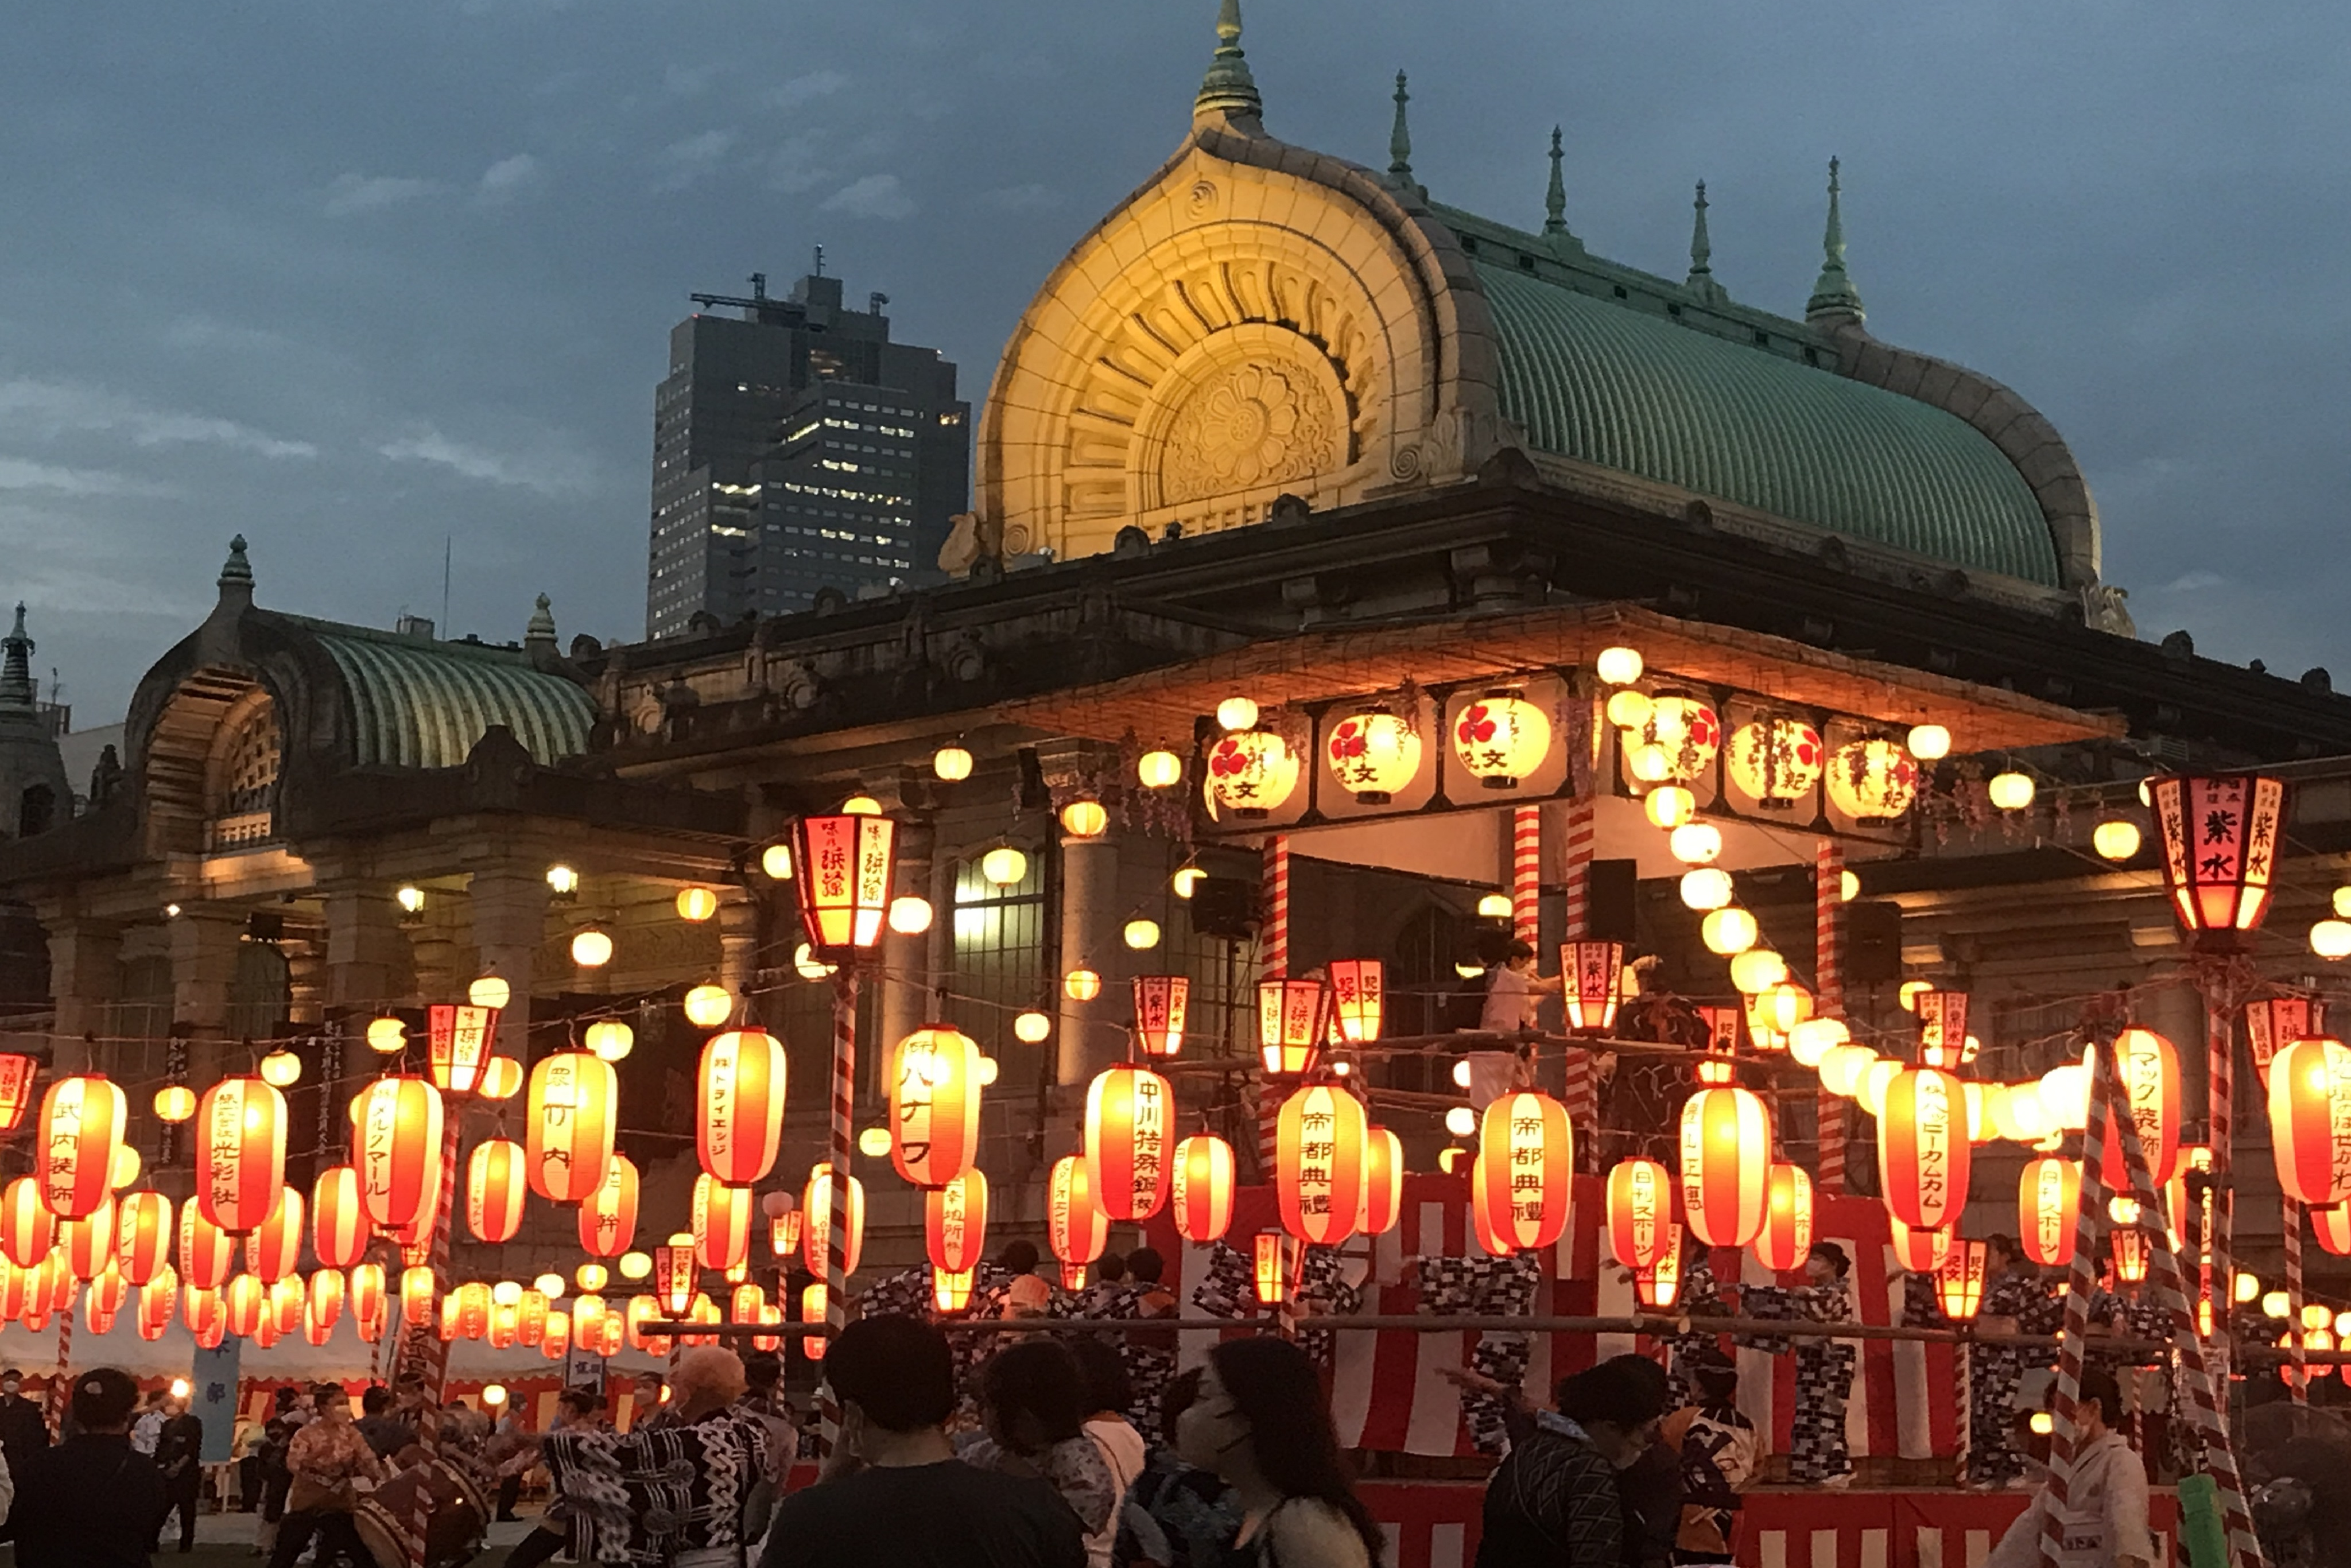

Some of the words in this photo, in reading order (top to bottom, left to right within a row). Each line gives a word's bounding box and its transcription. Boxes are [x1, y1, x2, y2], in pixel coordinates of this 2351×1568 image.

[2199, 810, 2238, 880] 紫水
[2247, 812, 2273, 876] 紫水
[1149, 994, 1164, 1027] 紫水
[1338, 976, 1356, 1004] 紀文
[1364, 975, 1378, 1003] 紀文
[1585, 960, 1604, 997] 紫水
[1925, 1009, 1939, 1040] 紫水
[45, 1102, 80, 1201] 武内装飾
[1297, 1112, 1336, 1216] 帝都典禮
[1510, 1117, 1545, 1222] 帝都典禮
[1173, 1148, 1190, 1233] 日スポーツ
[1632, 1171, 1655, 1257] 日刊スポーツ
[674, 1262, 688, 1289] 紫水
